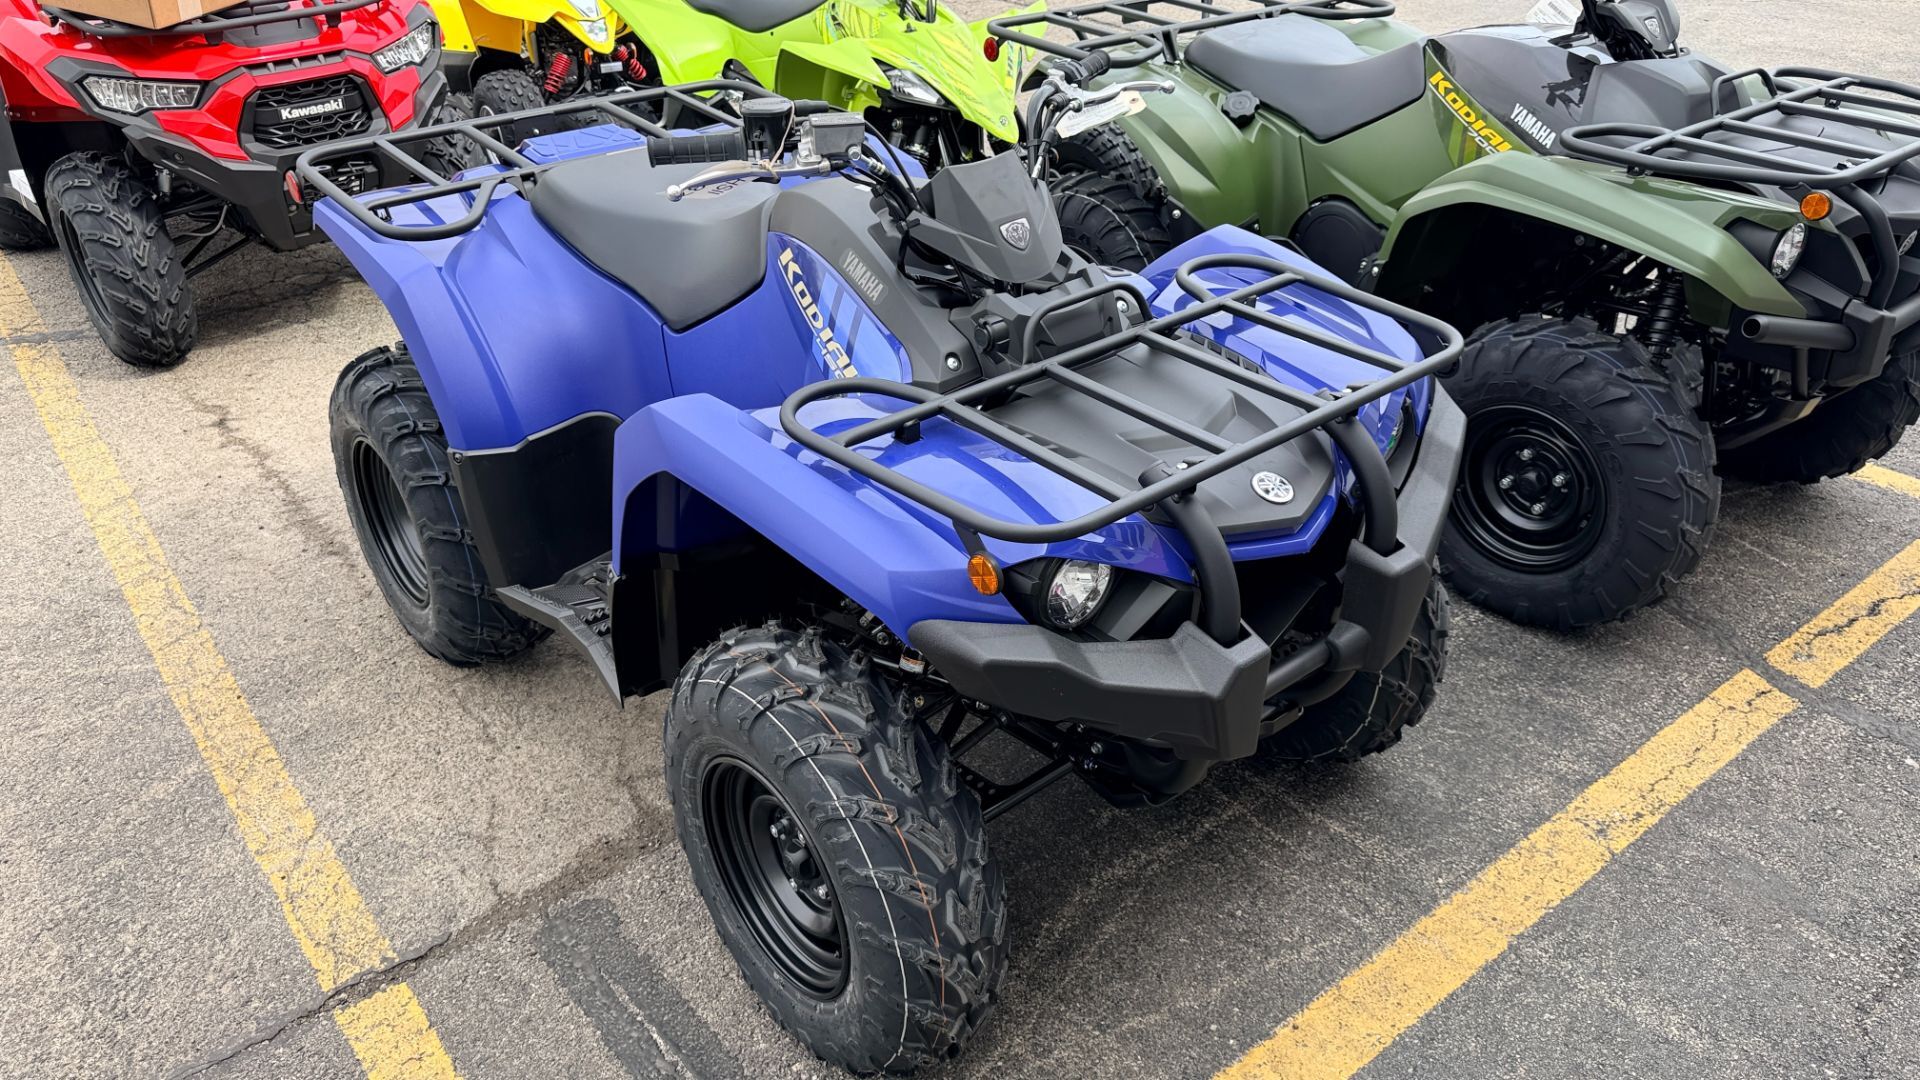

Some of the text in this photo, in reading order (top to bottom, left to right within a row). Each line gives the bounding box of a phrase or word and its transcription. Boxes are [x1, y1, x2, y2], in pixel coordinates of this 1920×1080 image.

[280, 99, 343, 119] Kawasaki
[1510, 103, 1556, 148] YAMAHA
[842, 252, 884, 301] YAMAHA
